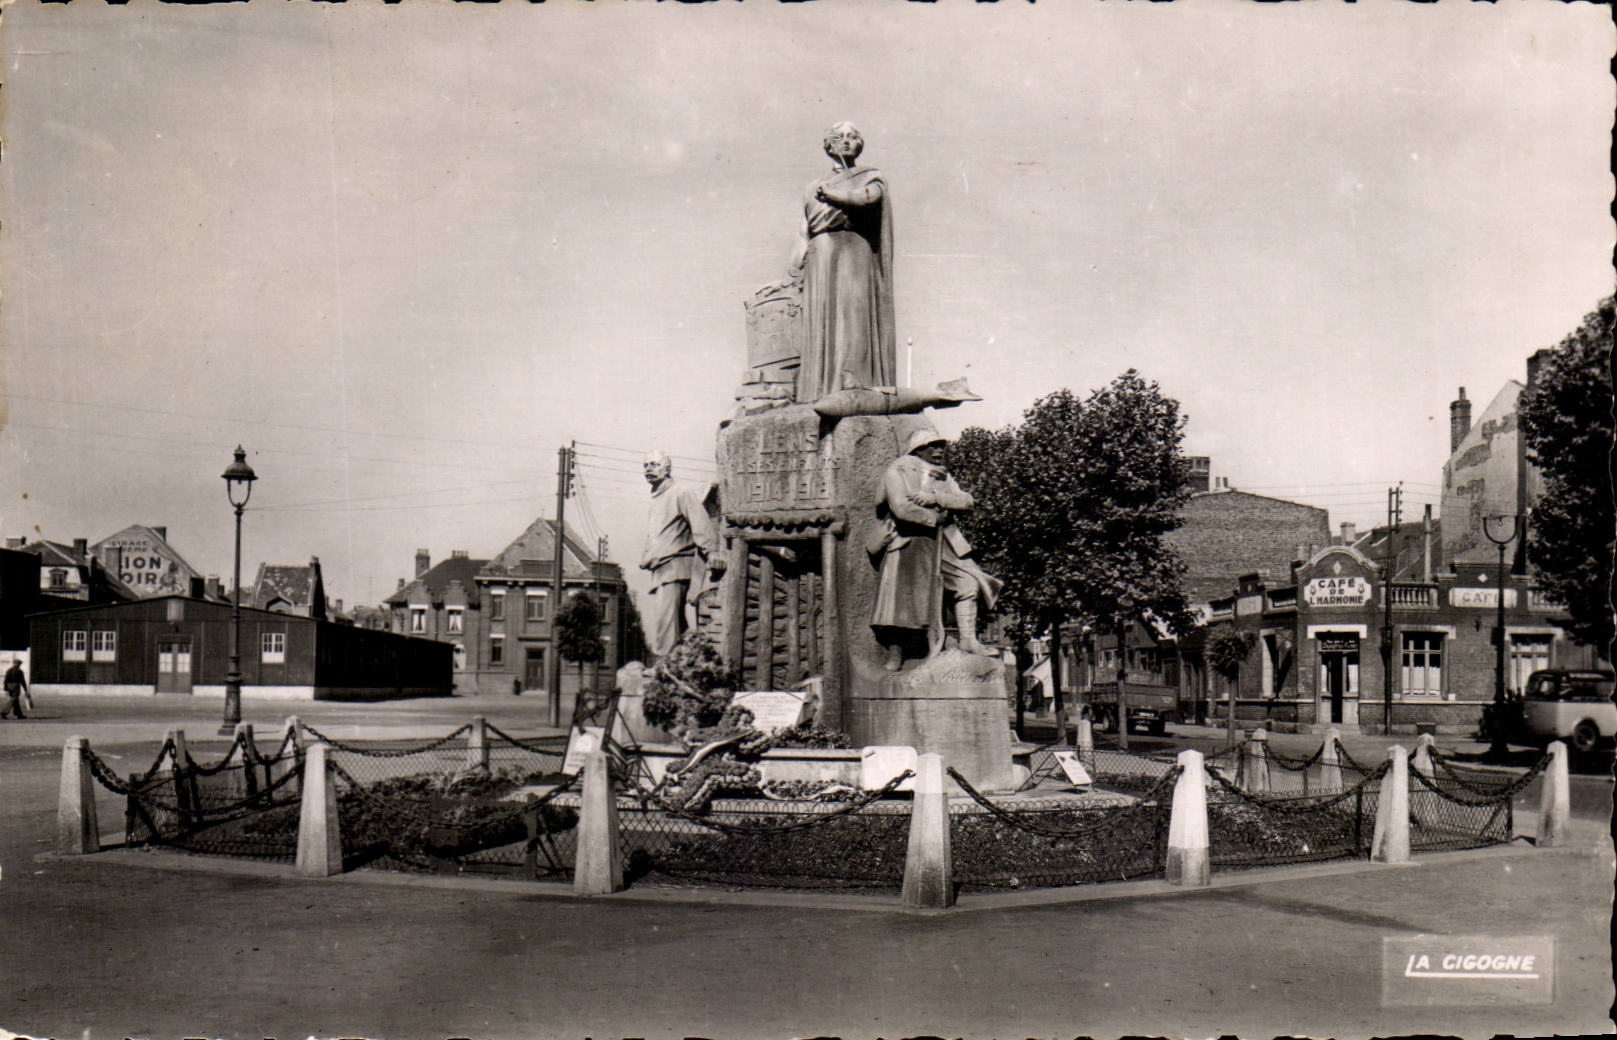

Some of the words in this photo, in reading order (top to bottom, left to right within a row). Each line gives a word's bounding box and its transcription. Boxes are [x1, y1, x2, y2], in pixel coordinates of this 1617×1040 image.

[759, 431, 819, 454] LENS
[120, 556, 161, 569] ION
[120, 572, 157, 584] OIR
